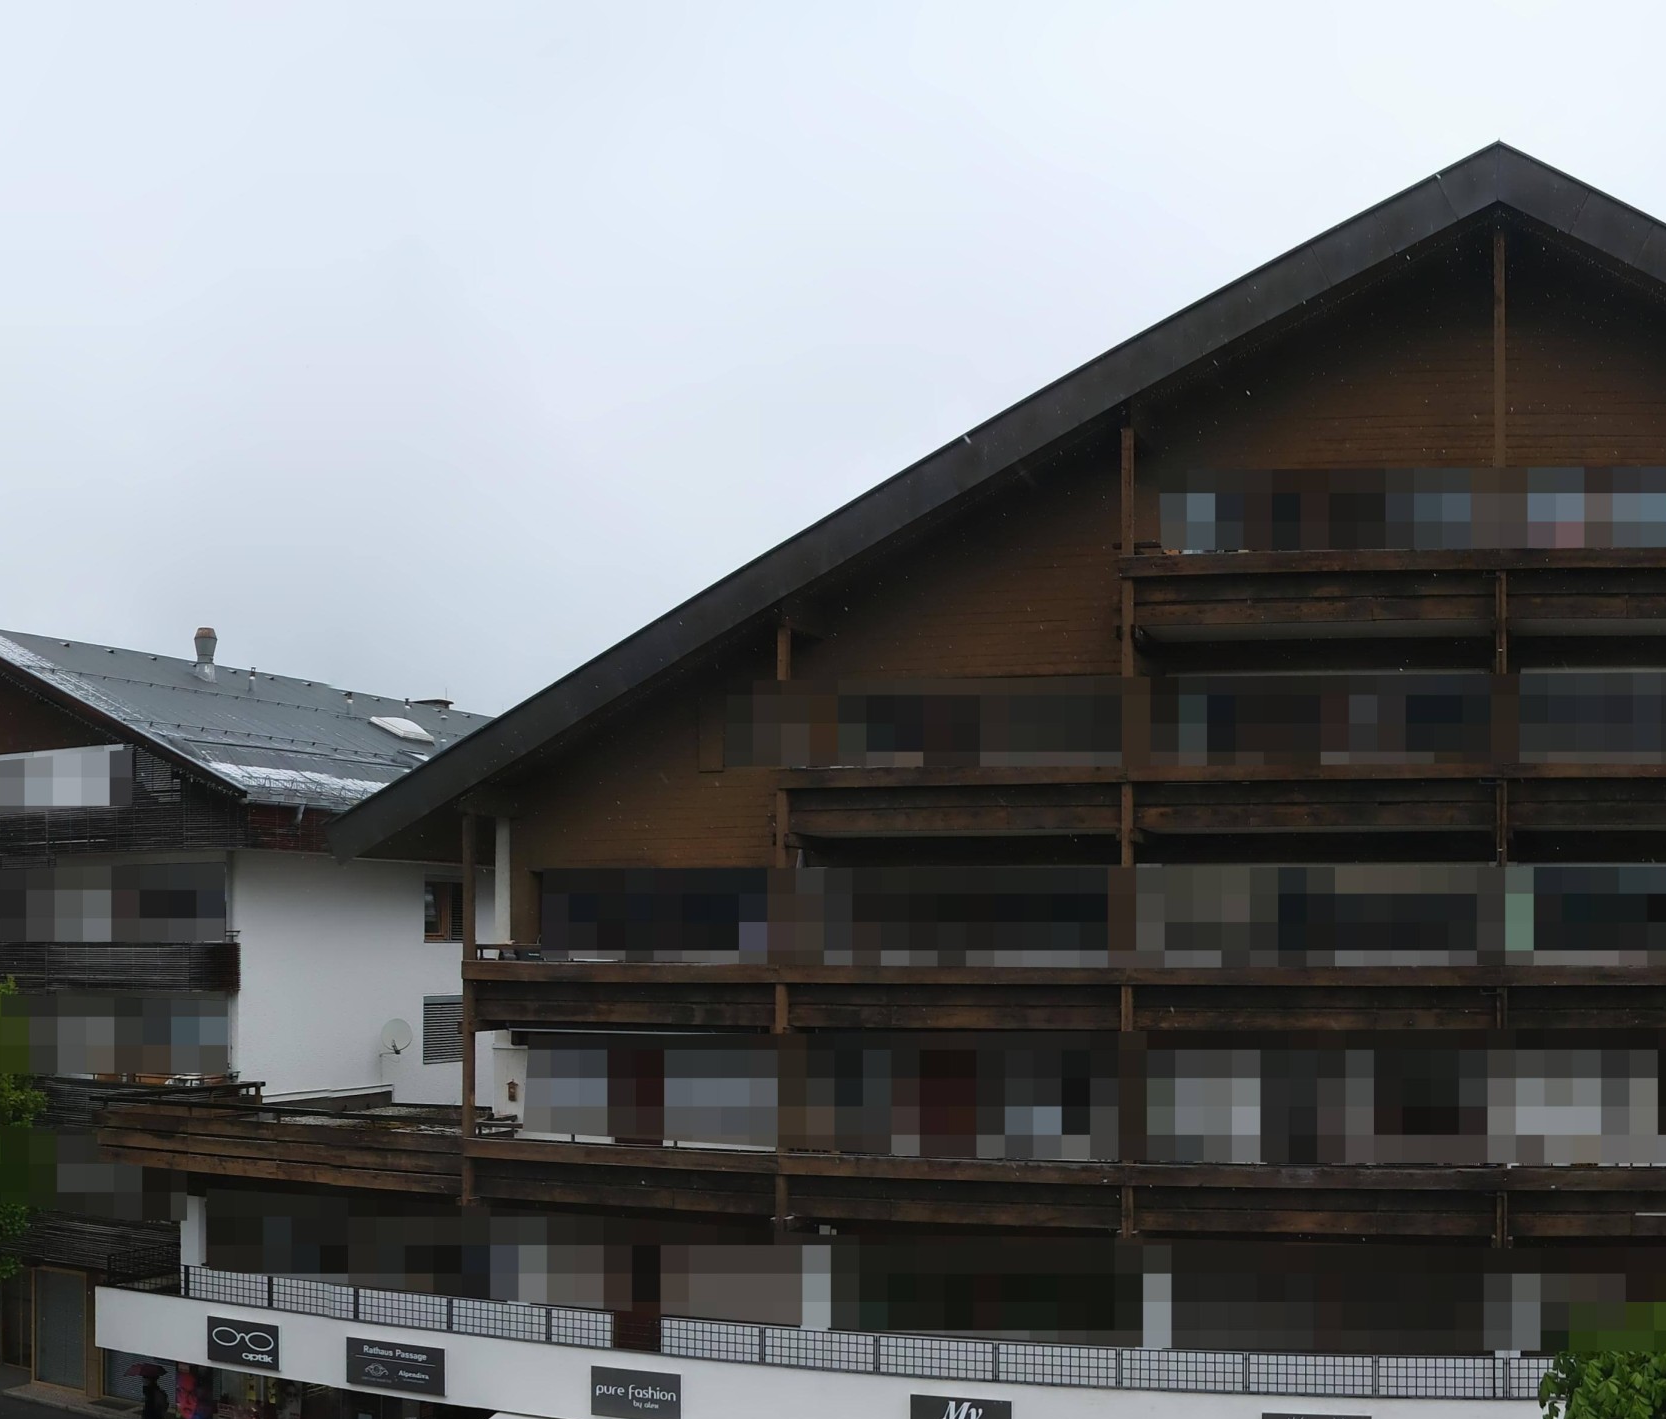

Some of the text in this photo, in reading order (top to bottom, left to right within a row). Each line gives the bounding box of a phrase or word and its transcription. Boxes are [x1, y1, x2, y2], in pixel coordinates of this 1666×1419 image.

[242, 1352, 273, 1365] optik
[363, 1344, 428, 1362] Rathaus Passage
[595, 1385, 677, 1401] pure fashion
[633, 1400, 659, 1409] by alex
